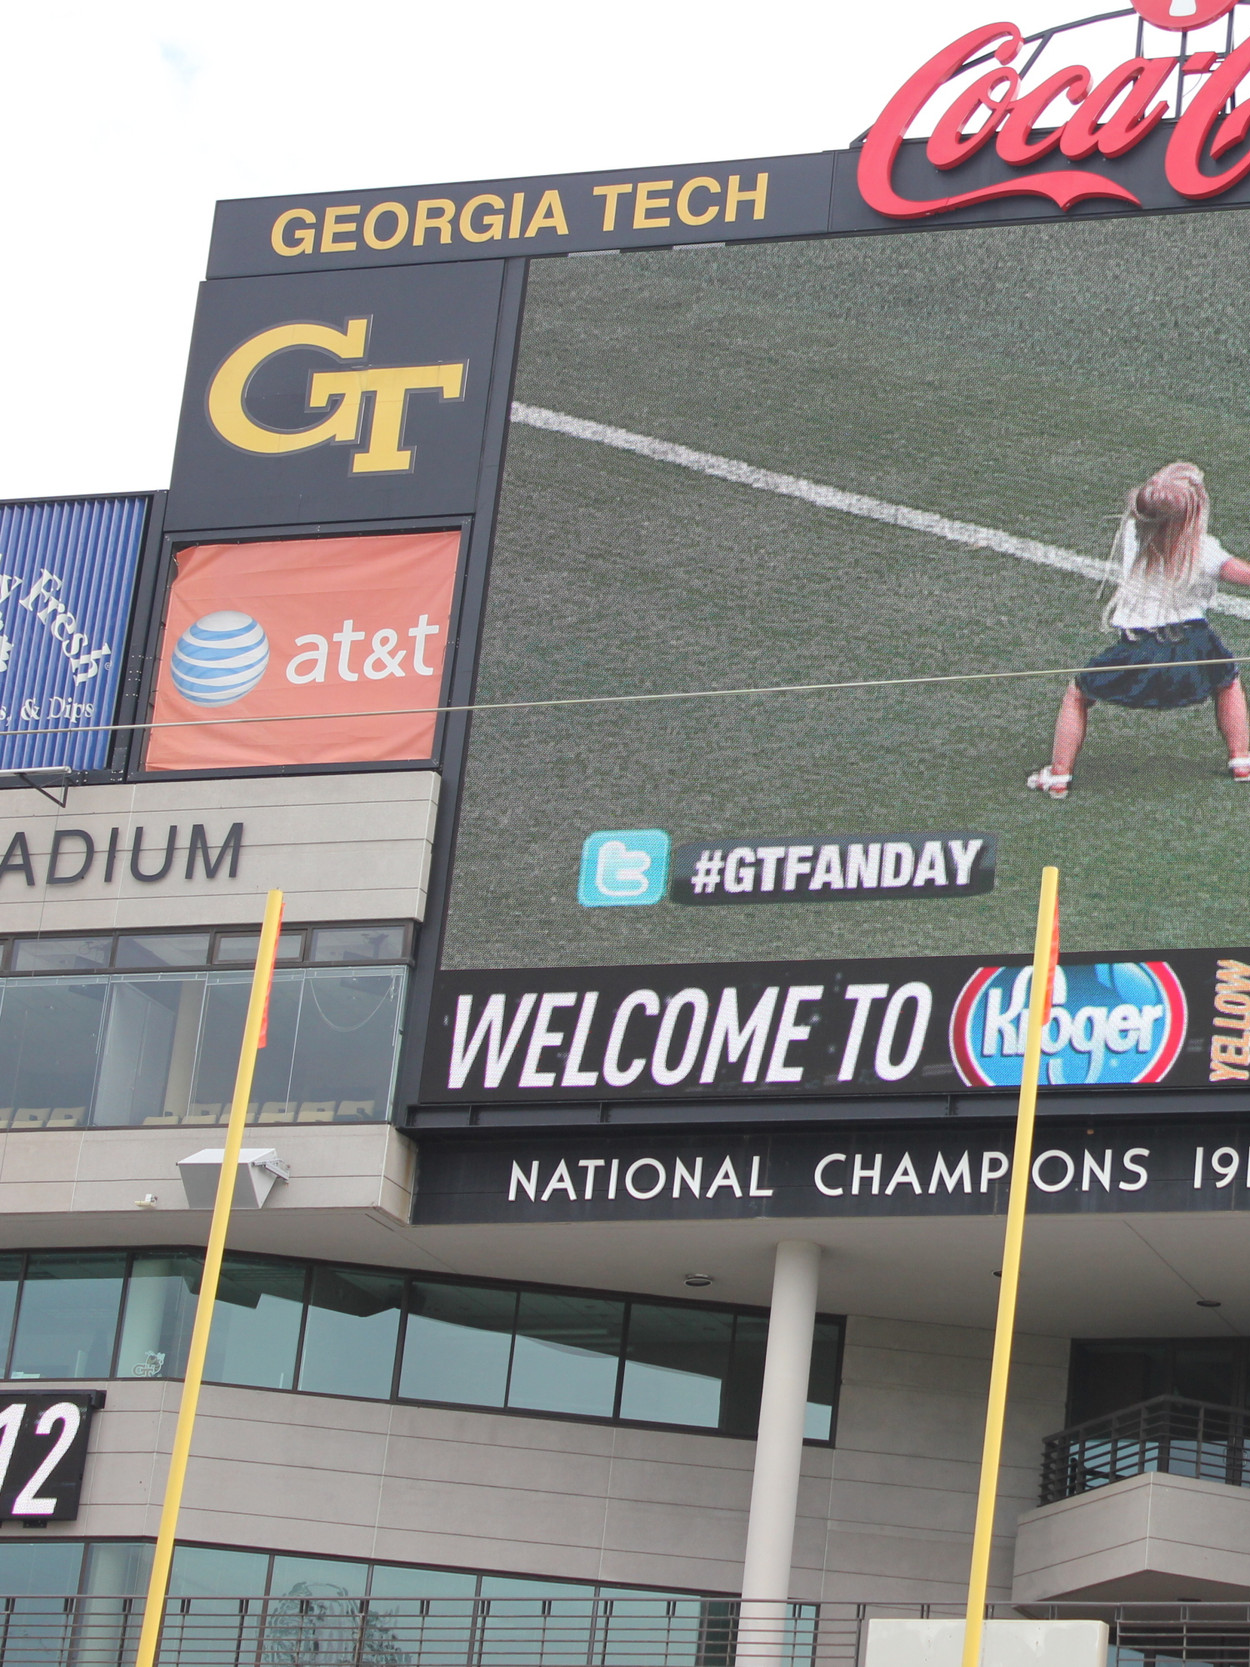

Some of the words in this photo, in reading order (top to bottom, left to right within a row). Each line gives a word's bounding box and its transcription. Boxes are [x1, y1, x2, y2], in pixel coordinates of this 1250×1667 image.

[271, 190, 569, 257] GEORGIA
[592, 173, 769, 231] TECH
[208, 319, 464, 473] GT
[19, 568, 112, 687] Fresh
[286, 614, 440, 684] at&t
[21, 698, 41, 721] &
[47, 696, 95, 723] Dips
[0, 822, 244, 886] ADIUM
[691, 839, 983, 894] #GTFANDAY
[448, 984, 825, 1089] WELCOME
[837, 981, 933, 1082] TO
[507, 1155, 774, 1202] NATIONAL
[813, 1147, 1150, 1197] CHAMPONS
[0, 1402, 81, 1515] 12
